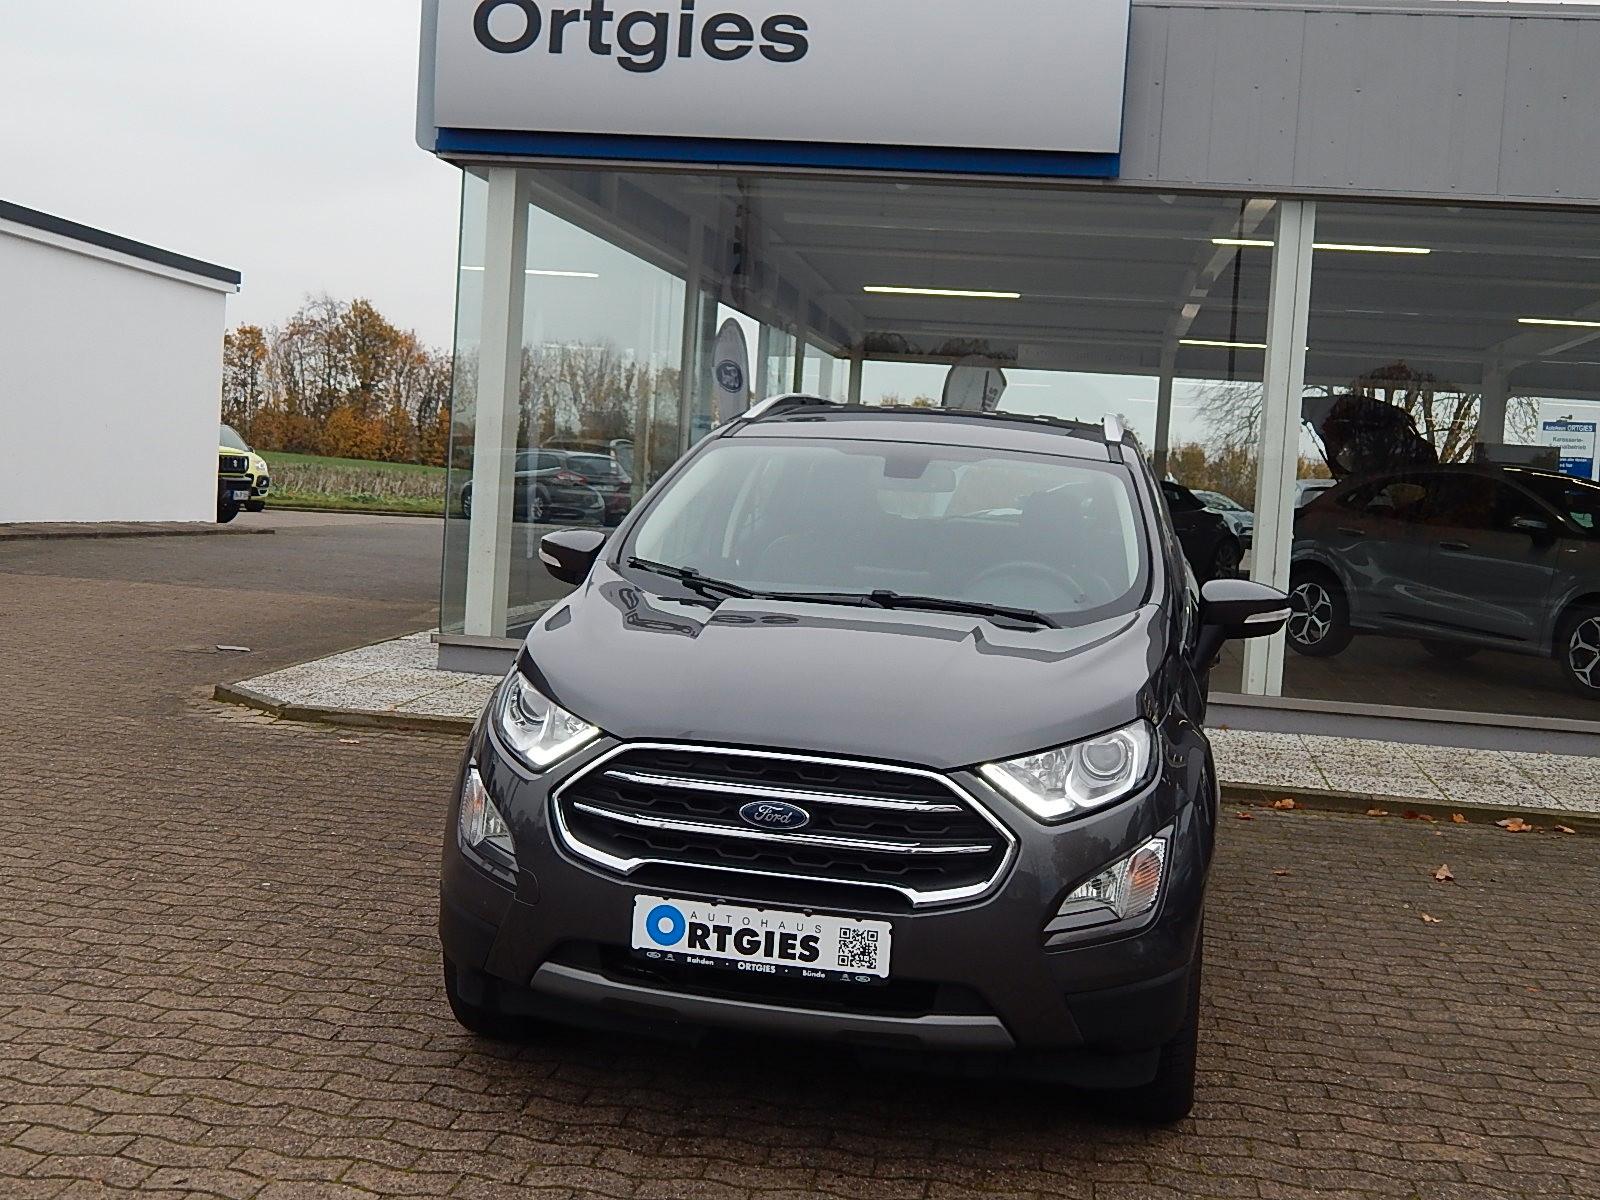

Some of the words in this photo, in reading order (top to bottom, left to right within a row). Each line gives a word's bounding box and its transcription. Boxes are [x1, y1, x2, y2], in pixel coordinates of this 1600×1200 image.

[473, 0, 809, 73] Ortgies
[754, 804, 792, 824] Ford
[646, 904, 820, 963] ORTGIES
[690, 911, 822, 934] AUTOHAUS
[686, 956, 714, 966] Rahden
[737, 961, 776, 974] ORTGIES
[802, 969, 826, 979] Bünde
